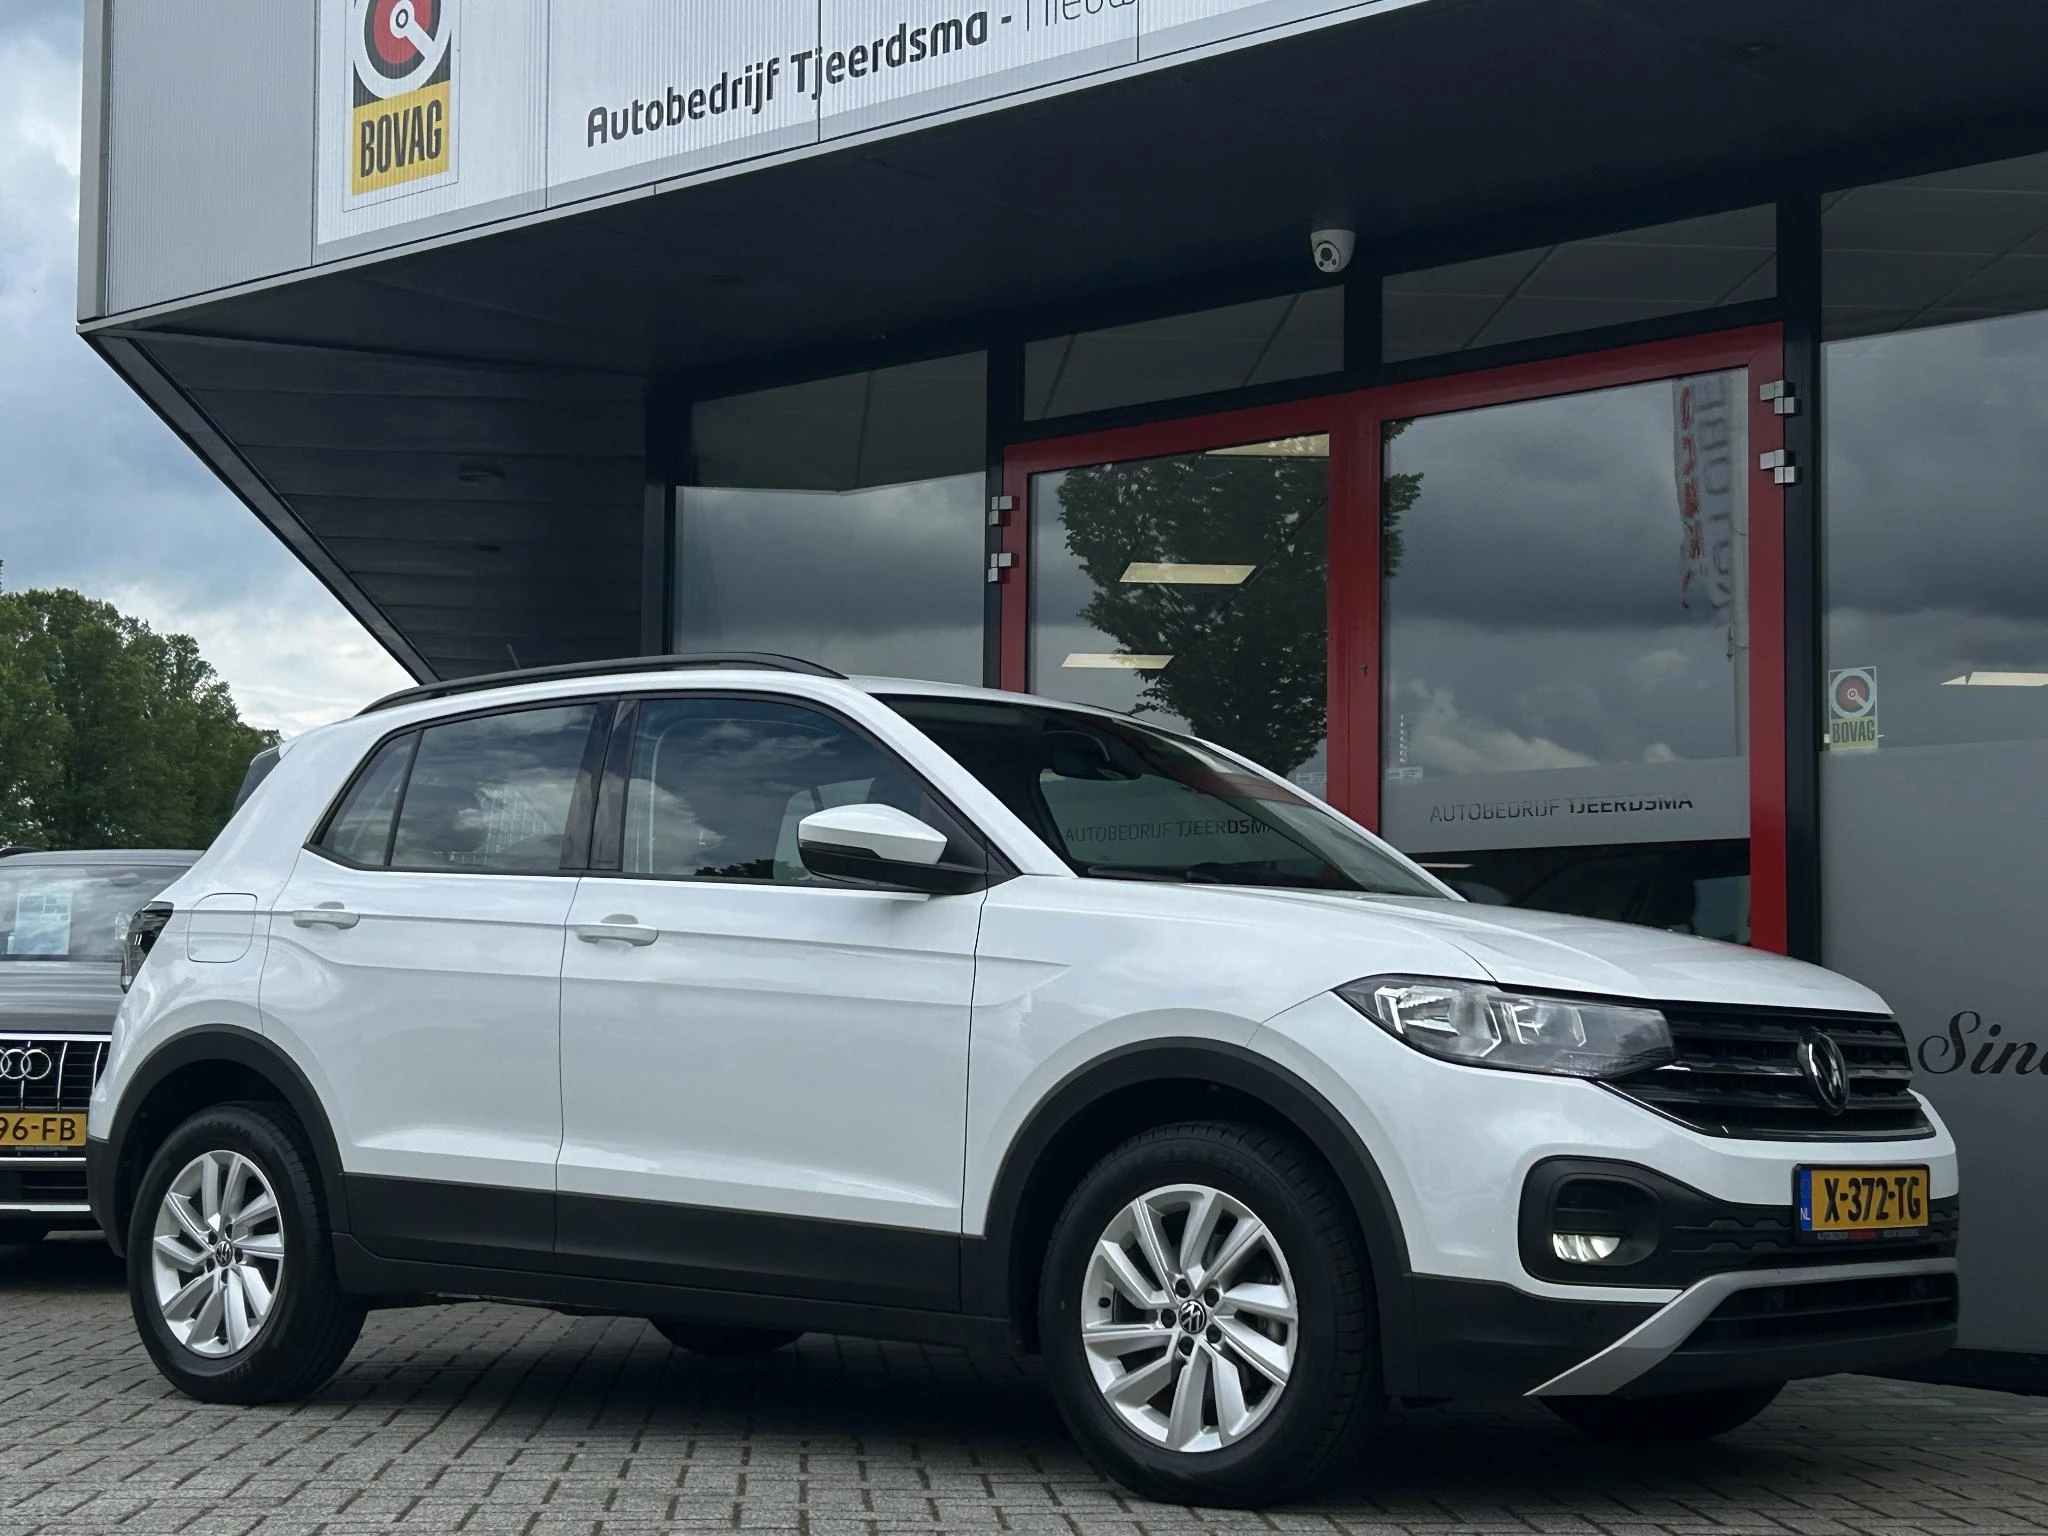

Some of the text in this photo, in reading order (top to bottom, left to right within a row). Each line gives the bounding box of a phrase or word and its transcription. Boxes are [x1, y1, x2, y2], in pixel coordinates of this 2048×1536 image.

[588, 57, 780, 148] Autobedrijf
[790, 11, 988, 101] Tjeerdsma
[1026, 0, 1136, 31] Nie
[361, 99, 442, 178] BOVAG
[1832, 720, 1875, 743] BOVAG
[1430, 799, 1560, 823] AUTOBEDRIJF
[1917, 1011, 2048, 1075] Sin
[1800, 1207, 1811, 1221] NL
[1824, 1176, 1921, 1222] X-372-TG
